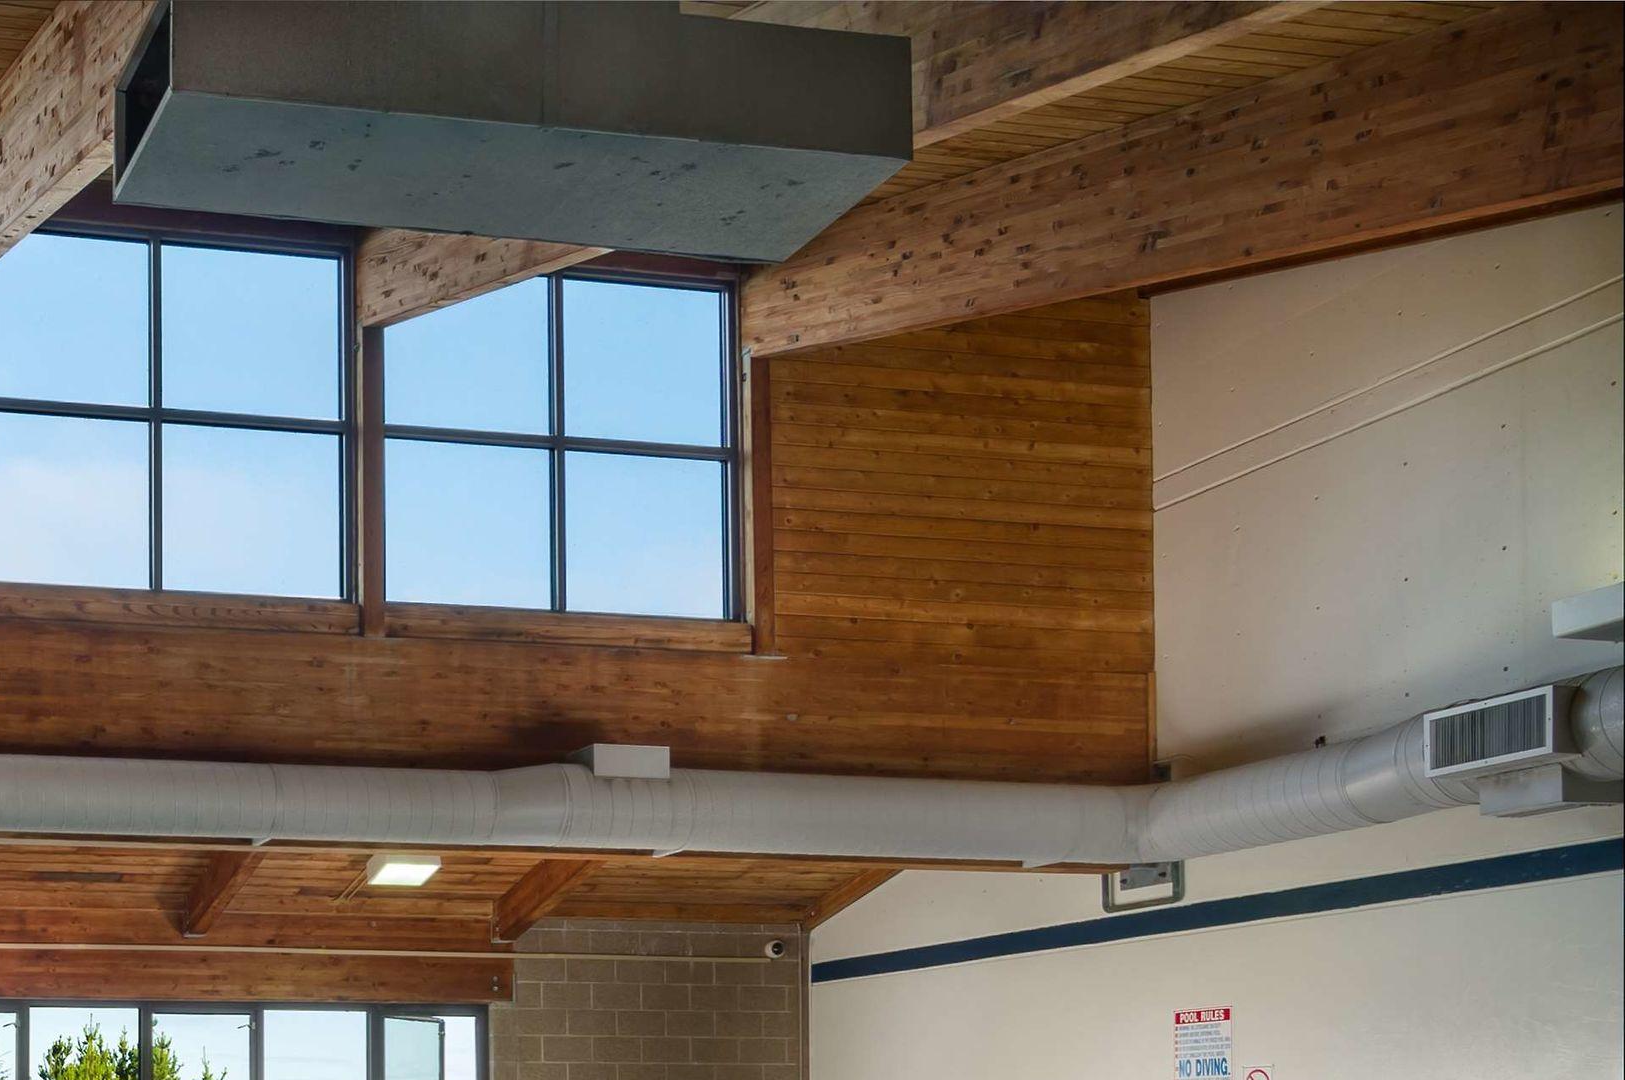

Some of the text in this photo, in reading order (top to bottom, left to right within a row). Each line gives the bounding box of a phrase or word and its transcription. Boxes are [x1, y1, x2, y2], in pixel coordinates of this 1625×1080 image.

[1179, 1009, 1225, 1024] POOL RULES
[1178, 1057, 1231, 1078] NO DIVING.
